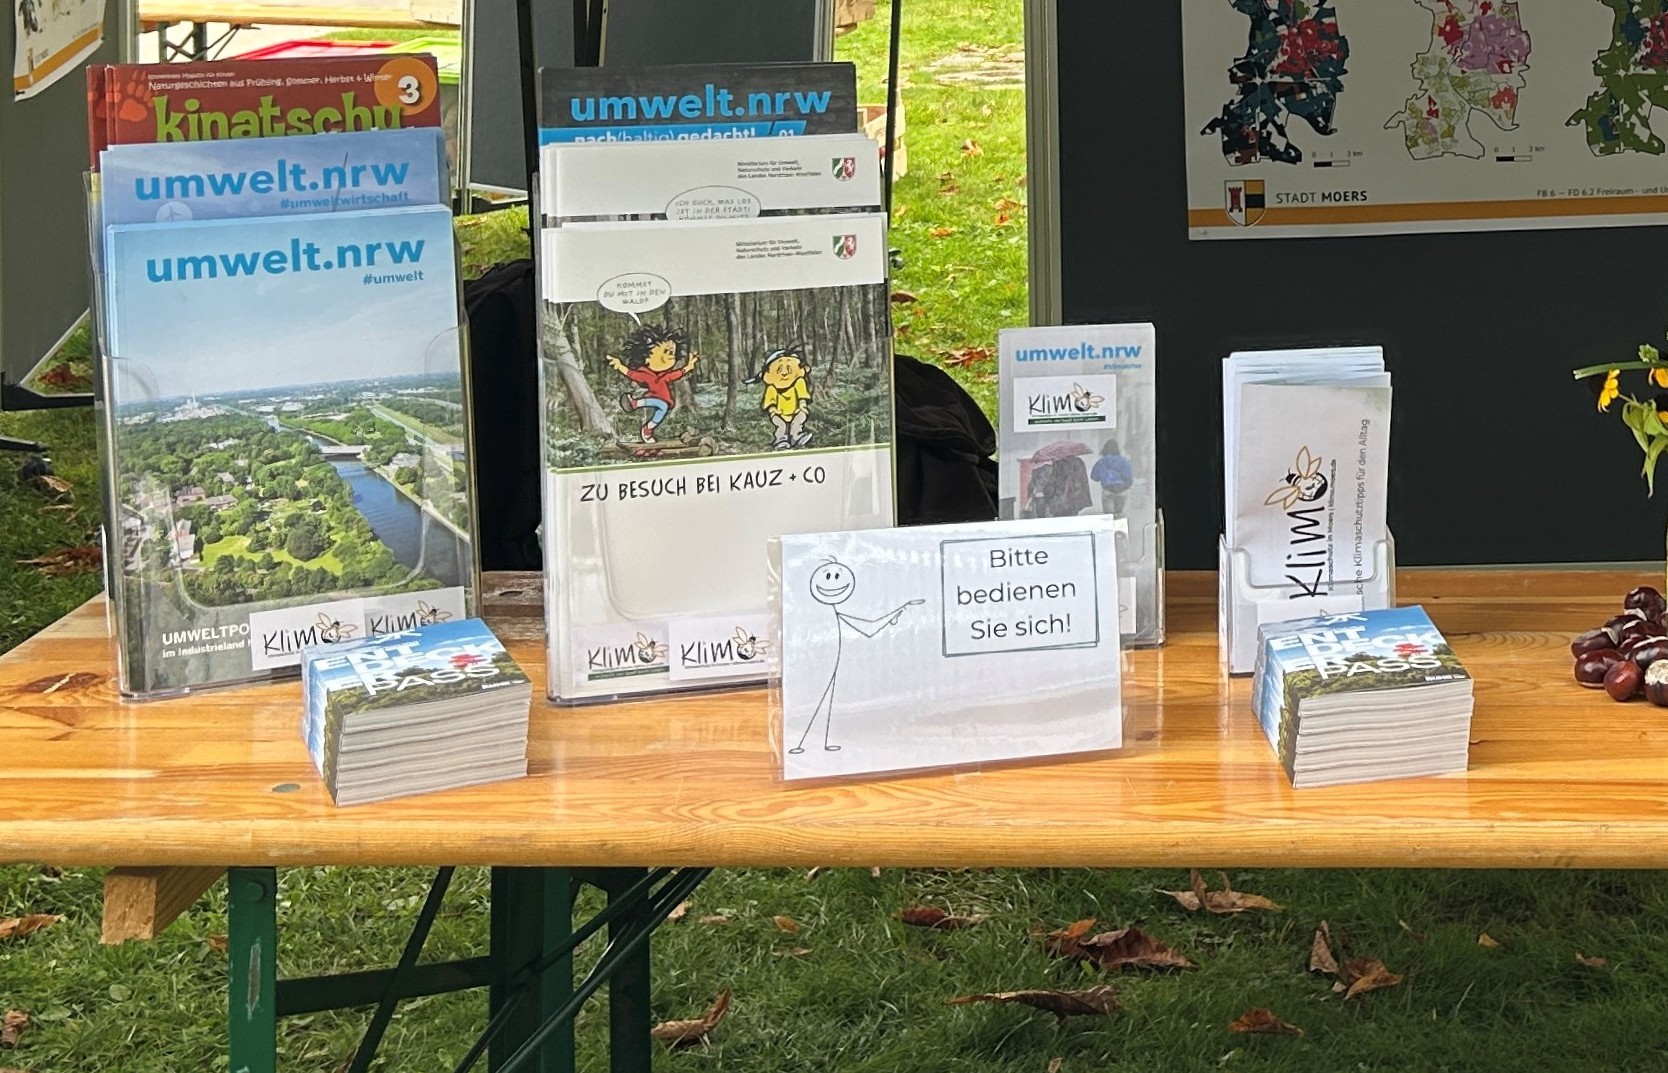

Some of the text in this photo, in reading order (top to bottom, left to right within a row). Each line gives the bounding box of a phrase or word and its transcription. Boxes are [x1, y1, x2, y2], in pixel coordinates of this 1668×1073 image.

[398, 75, 420, 104] 3
[570, 83, 832, 122] umwelt.nrw
[152, 92, 404, 142] kinatschu
[135, 158, 410, 202] umwelt.nrw
[1536, 188, 1548, 198] FB
[1567, 187, 1580, 197] FD
[1641, 185, 1659, 195] und
[279, 190, 409, 210] #umweltwirtschaft
[1276, 190, 1368, 204] STADT MOERS
[146, 238, 426, 284] umwelt.nrw
[362, 270, 425, 287] #umwelt
[1015, 342, 1142, 362] umwelt.nrw
[1358, 447, 1368, 466] den
[580, 482, 609, 502] ZU
[618, 475, 687, 501] BESUCH
[696, 474, 721, 495] BEI
[729, 468, 783, 492] KAUZ
[802, 465, 827, 485] CO
[989, 546, 1049, 569] Bitte
[956, 579, 1077, 606] bedienen
[161, 623, 251, 646] UMWELTPO
[970, 613, 1072, 641] Sie sich!
[161, 639, 246, 659] im Industrieland
[1316, 655, 1442, 679] PASS
[366, 664, 501, 696] PASS
